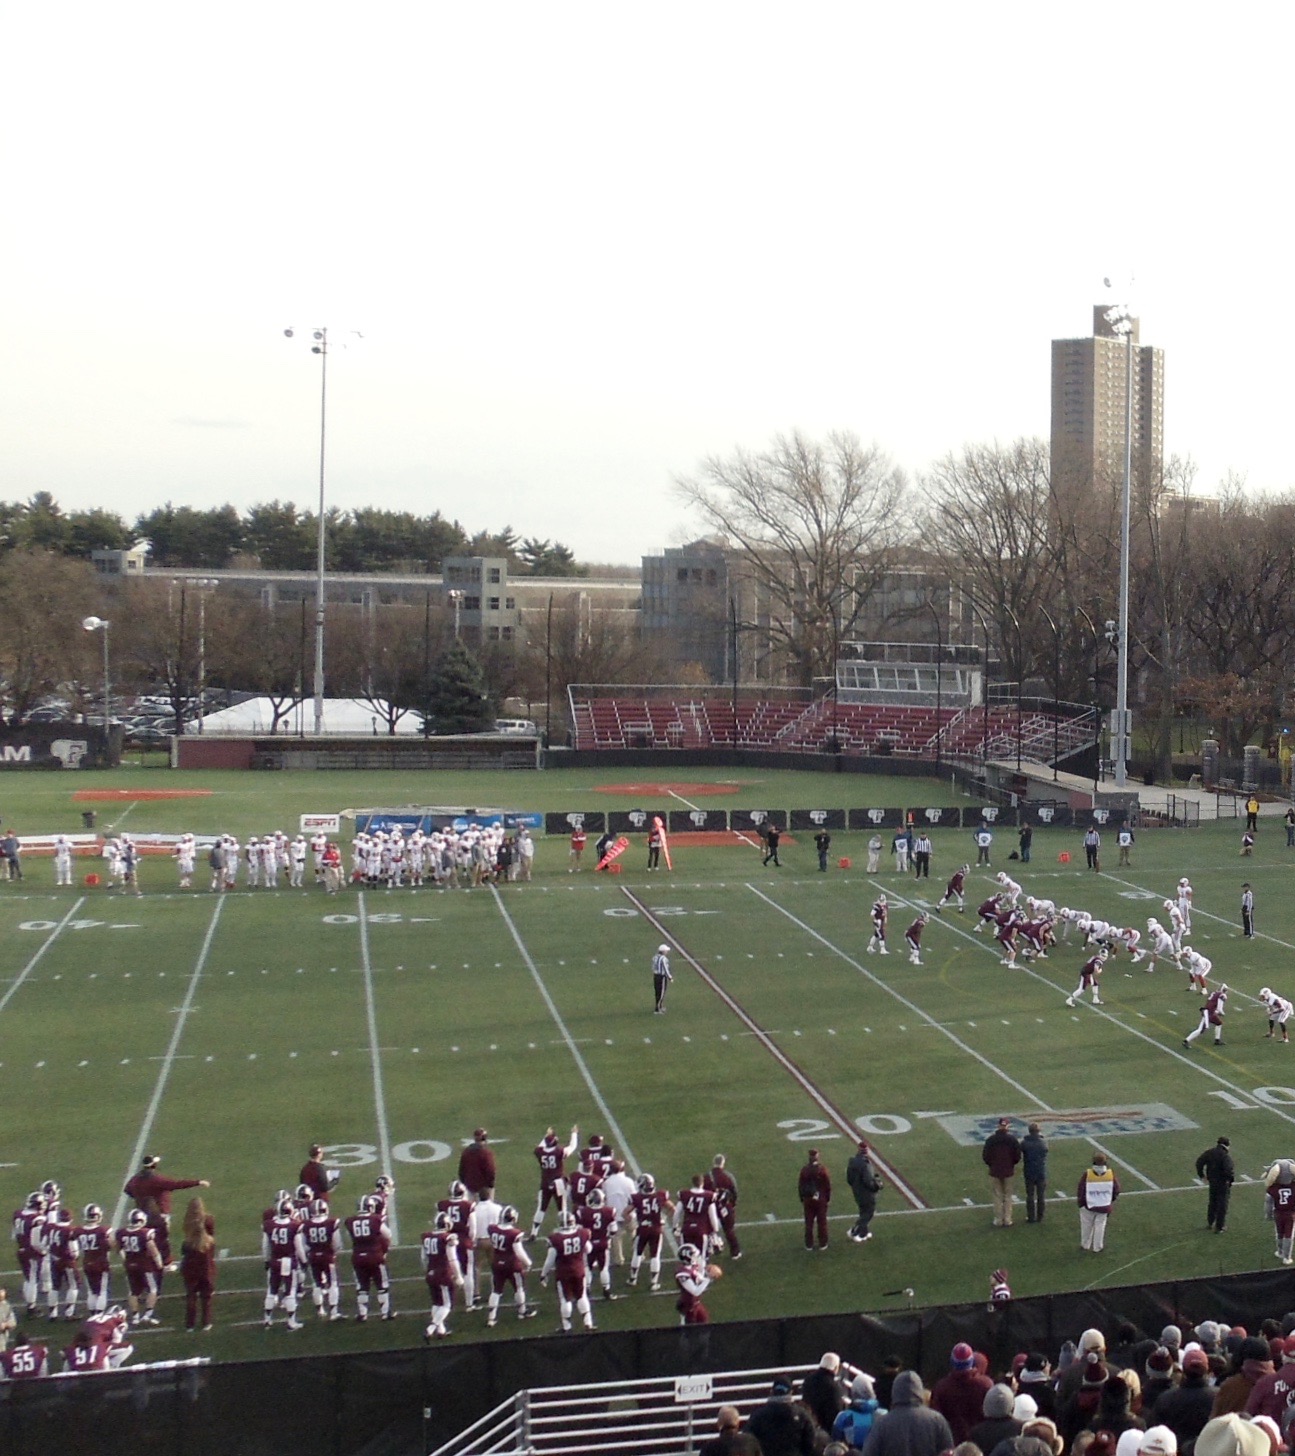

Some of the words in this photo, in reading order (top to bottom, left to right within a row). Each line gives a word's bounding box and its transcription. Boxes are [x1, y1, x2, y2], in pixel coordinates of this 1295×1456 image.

[305, 818, 336, 826] ESPN
[776, 1114, 912, 1142] 20
[316, 1140, 452, 1167] 30
[602, 1163, 611, 1179] 2
[577, 1177, 587, 1194] 6
[1278, 1188, 1292, 1205] F
[642, 1198, 659, 1215] 54
[686, 1197, 704, 1214] 47
[352, 1219, 371, 1237] 66
[592, 1212, 602, 1230] 3
[79, 1233, 99, 1250] 82
[271, 1227, 288, 1245] 49
[309, 1227, 328, 1243] 88
[490, 1233, 506, 1251] 92
[121, 1236, 140, 1252] 38
[423, 1237, 438, 1255] 90
[563, 1237, 581, 1255] 68
[12, 1350, 35, 1373] 55
[682, 1384, 705, 1394] EXIT
